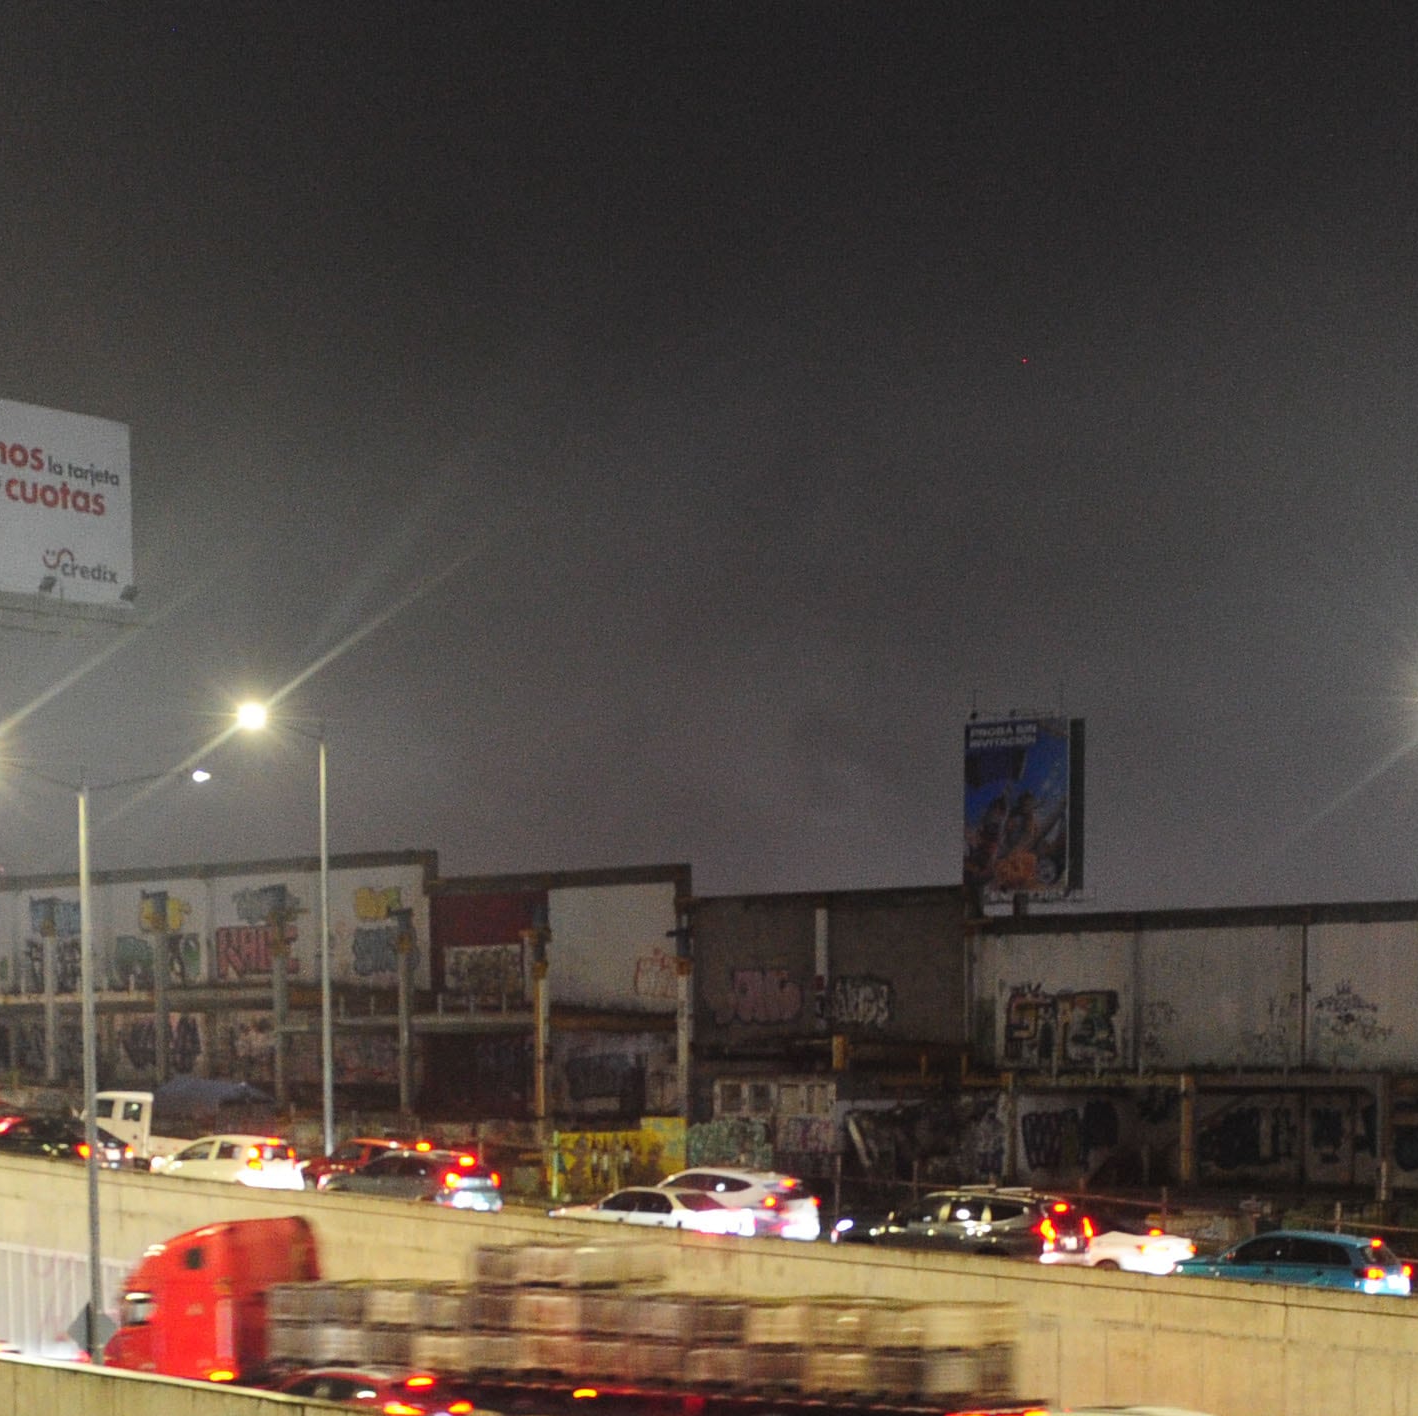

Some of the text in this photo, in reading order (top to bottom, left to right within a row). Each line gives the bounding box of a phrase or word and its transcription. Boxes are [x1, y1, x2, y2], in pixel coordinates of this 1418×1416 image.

[47, 455, 63, 476] la
[68, 462, 120, 487] tarjeta
[5, 477, 106, 516] cuotas
[60, 562, 118, 584] credix
